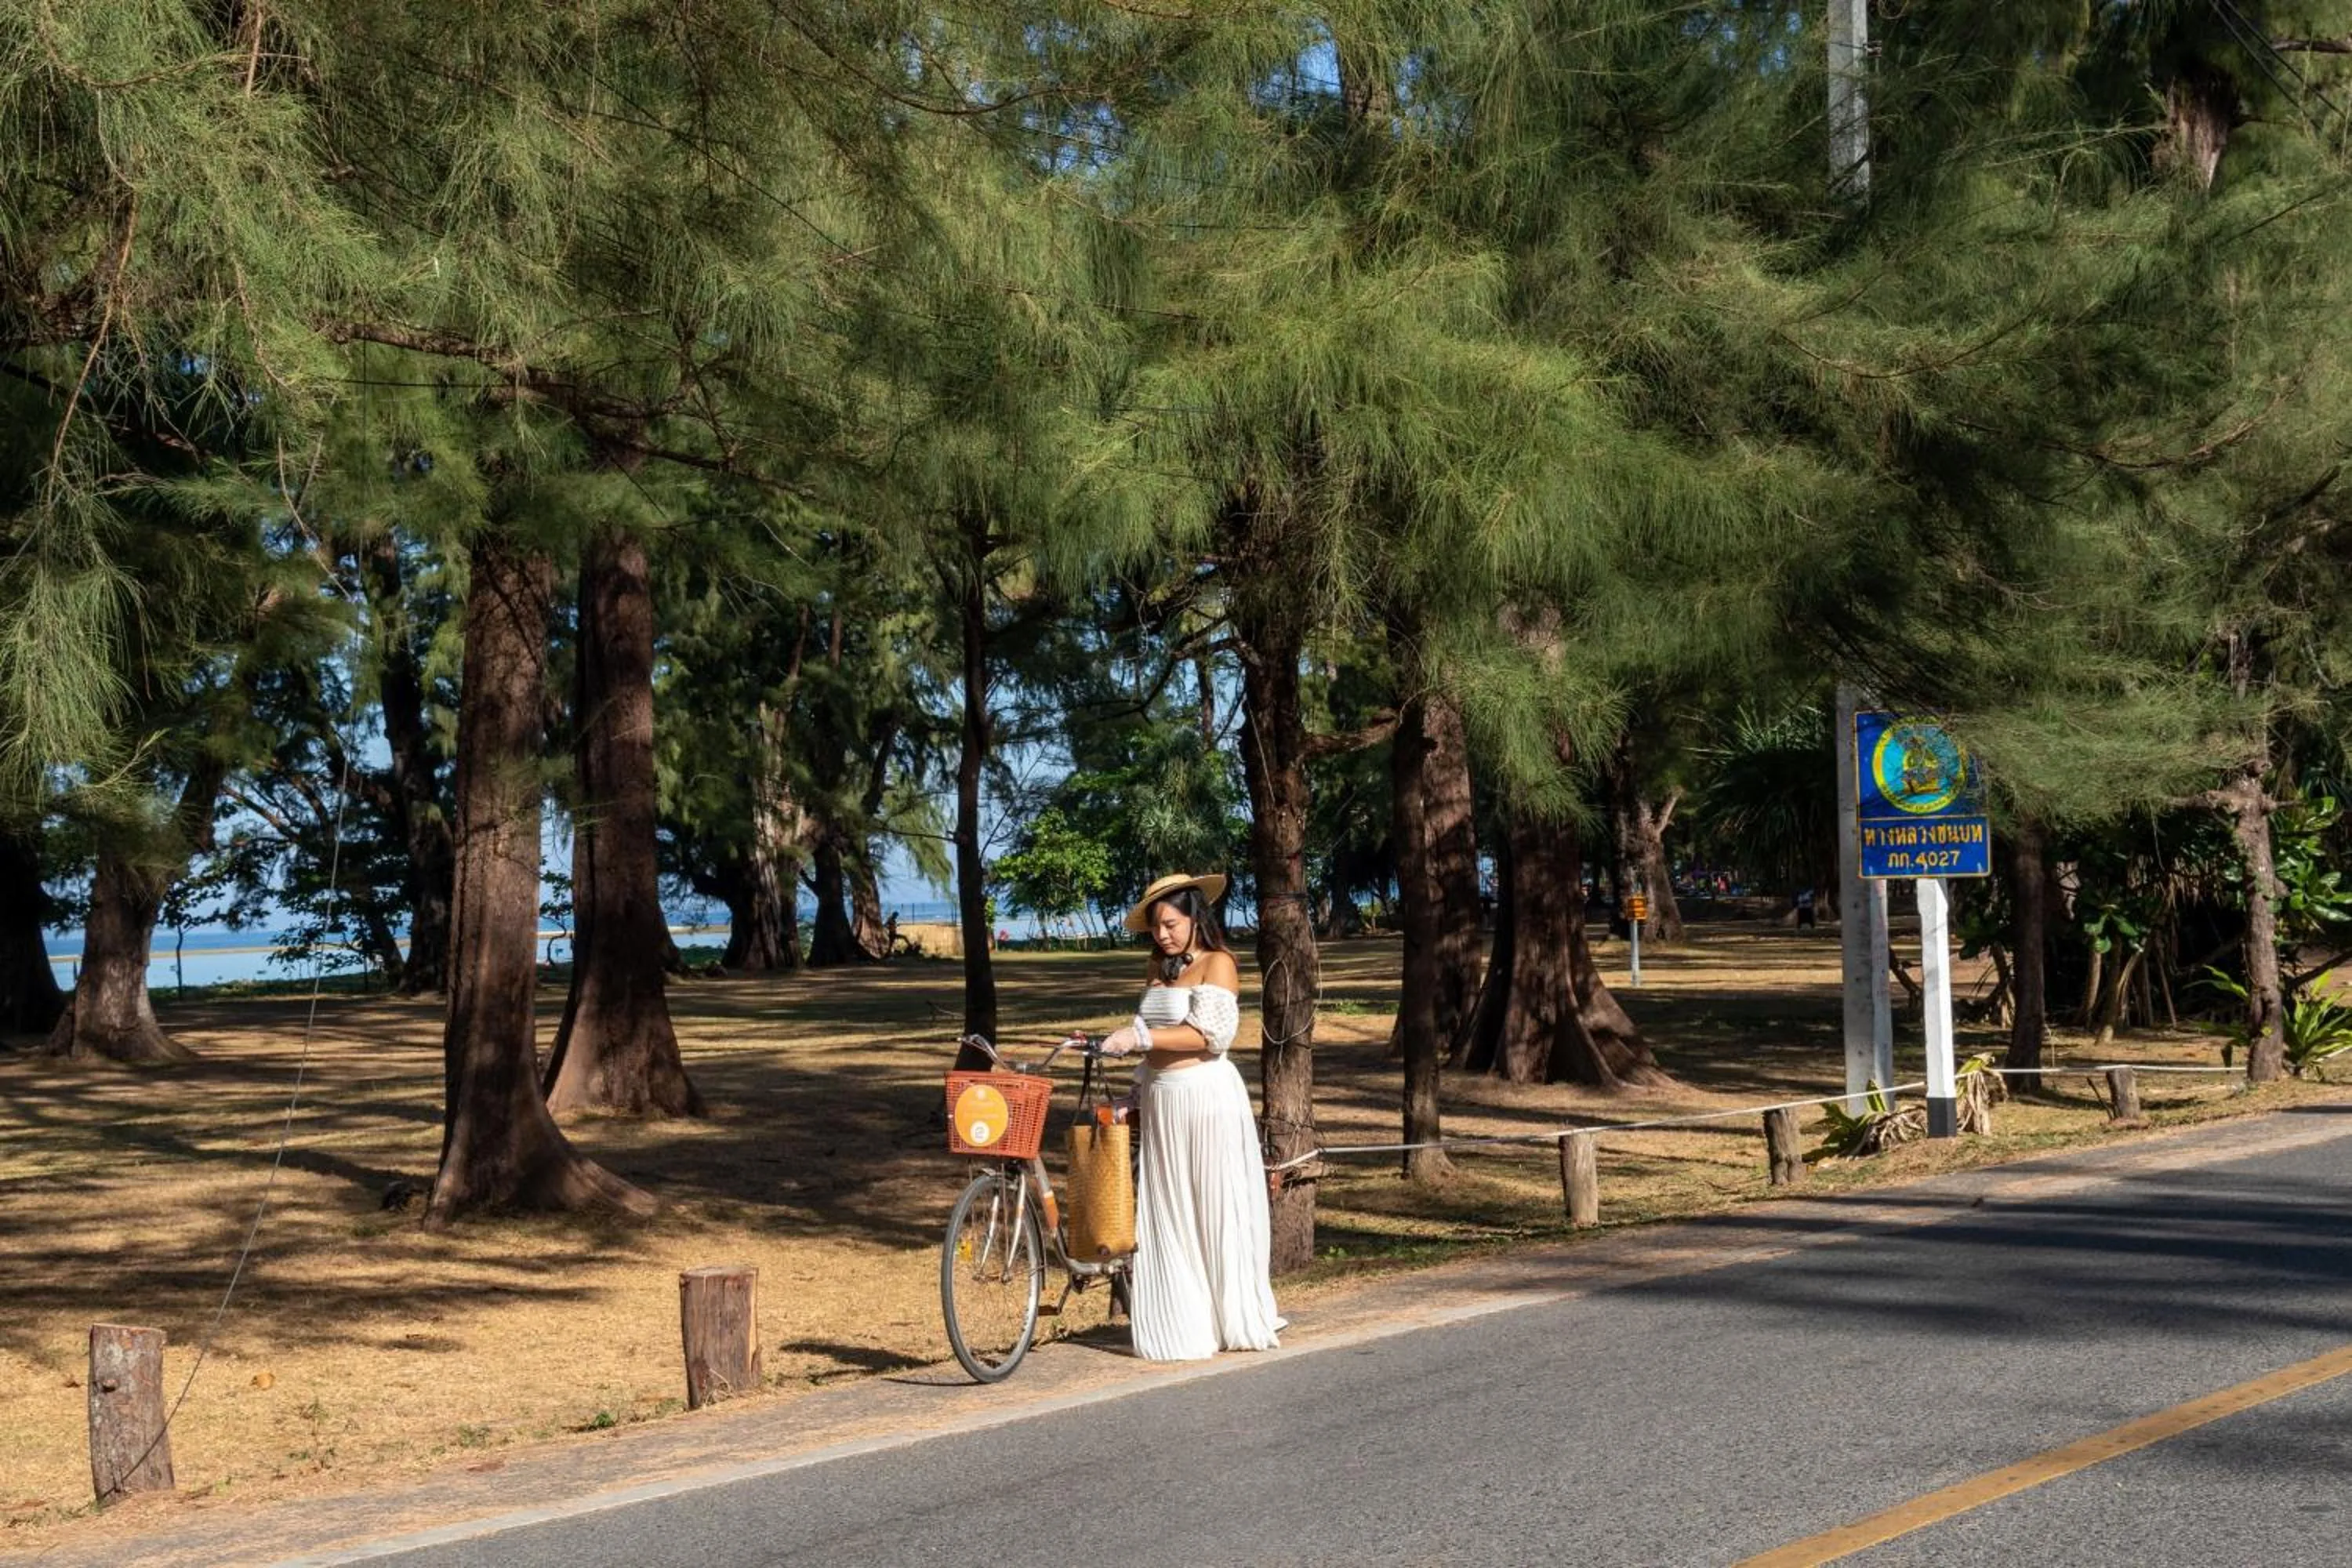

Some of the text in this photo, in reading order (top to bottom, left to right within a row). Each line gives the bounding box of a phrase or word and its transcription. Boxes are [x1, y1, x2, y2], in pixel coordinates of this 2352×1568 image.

[1864, 824, 1983, 846] ทางหลวงชนบท
